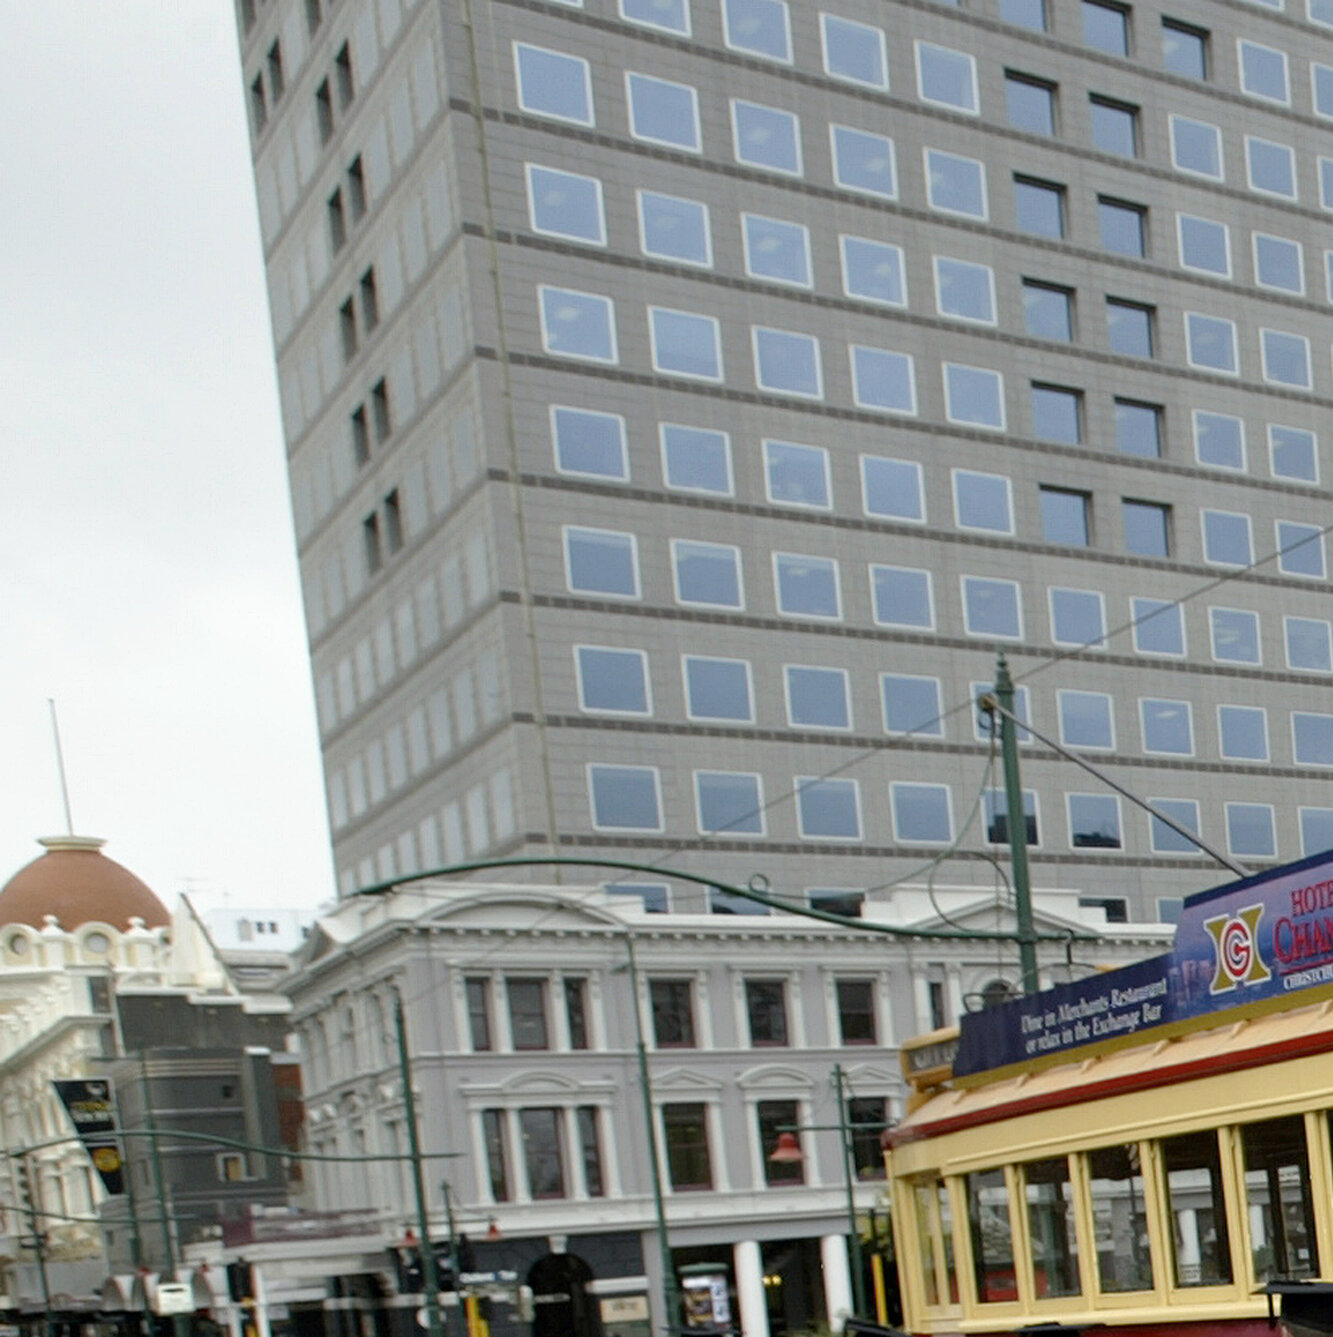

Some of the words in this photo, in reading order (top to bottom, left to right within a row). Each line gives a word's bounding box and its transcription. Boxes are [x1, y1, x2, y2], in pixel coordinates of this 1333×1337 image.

[1111, 978, 1167, 1008] Restaurant
[1074, 1020, 1090, 1041] the
[1092, 1011, 1140, 1036] Exchange
[1142, 1002, 1162, 1023] Bar
